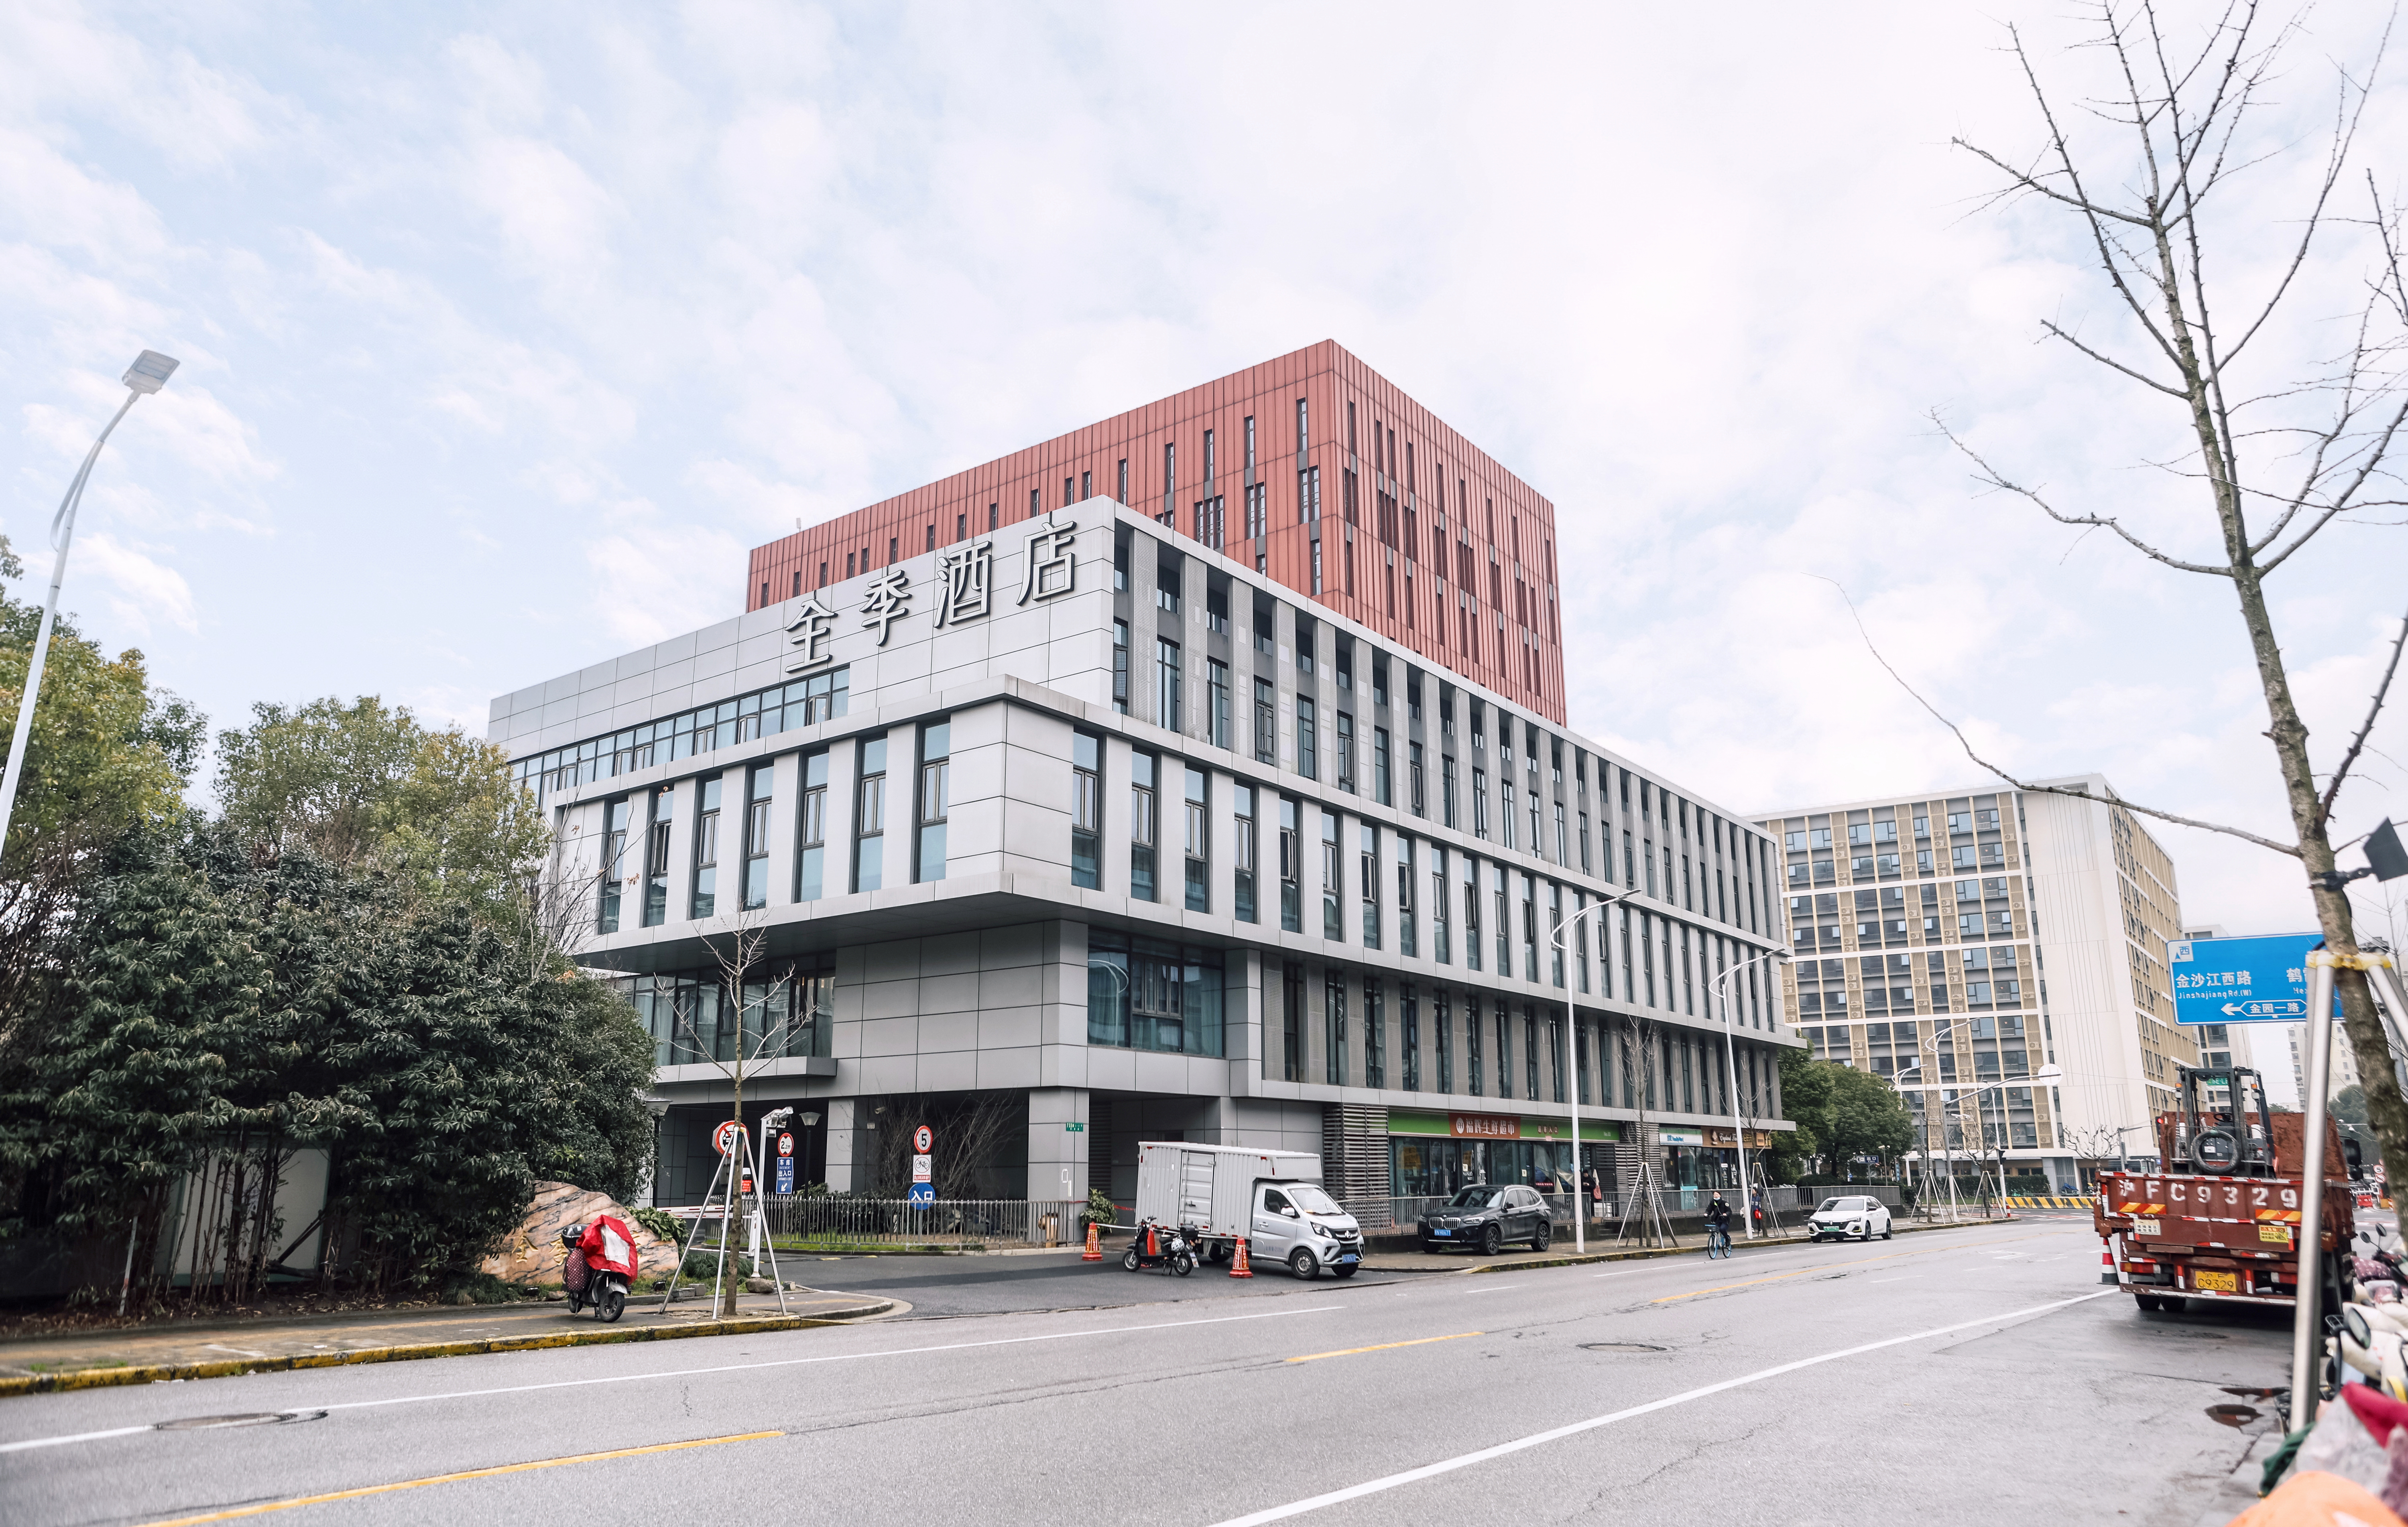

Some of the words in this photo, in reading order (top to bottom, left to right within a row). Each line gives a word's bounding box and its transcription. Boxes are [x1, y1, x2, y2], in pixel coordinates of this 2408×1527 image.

[785, 520, 1077, 674] 全季酒店
[2179, 946, 2190, 955] 西
[2176, 970, 2252, 988] 金沙江西路
[2286, 967, 2307, 983] 鹤
[2178, 991, 2227, 1000] Jinshajiang
[2228, 989, 2252, 997] Rd.(W)
[2250, 1002, 2300, 1014] 金园一路
[1466, 1118, 1515, 1135] 福辉生鲜超市
[781, 1141, 791, 1149] 2.2m
[921, 1133, 927, 1147] 5
[911, 1190, 933, 1201] 入口
[2198, 1278, 2234, 1290] C9329
